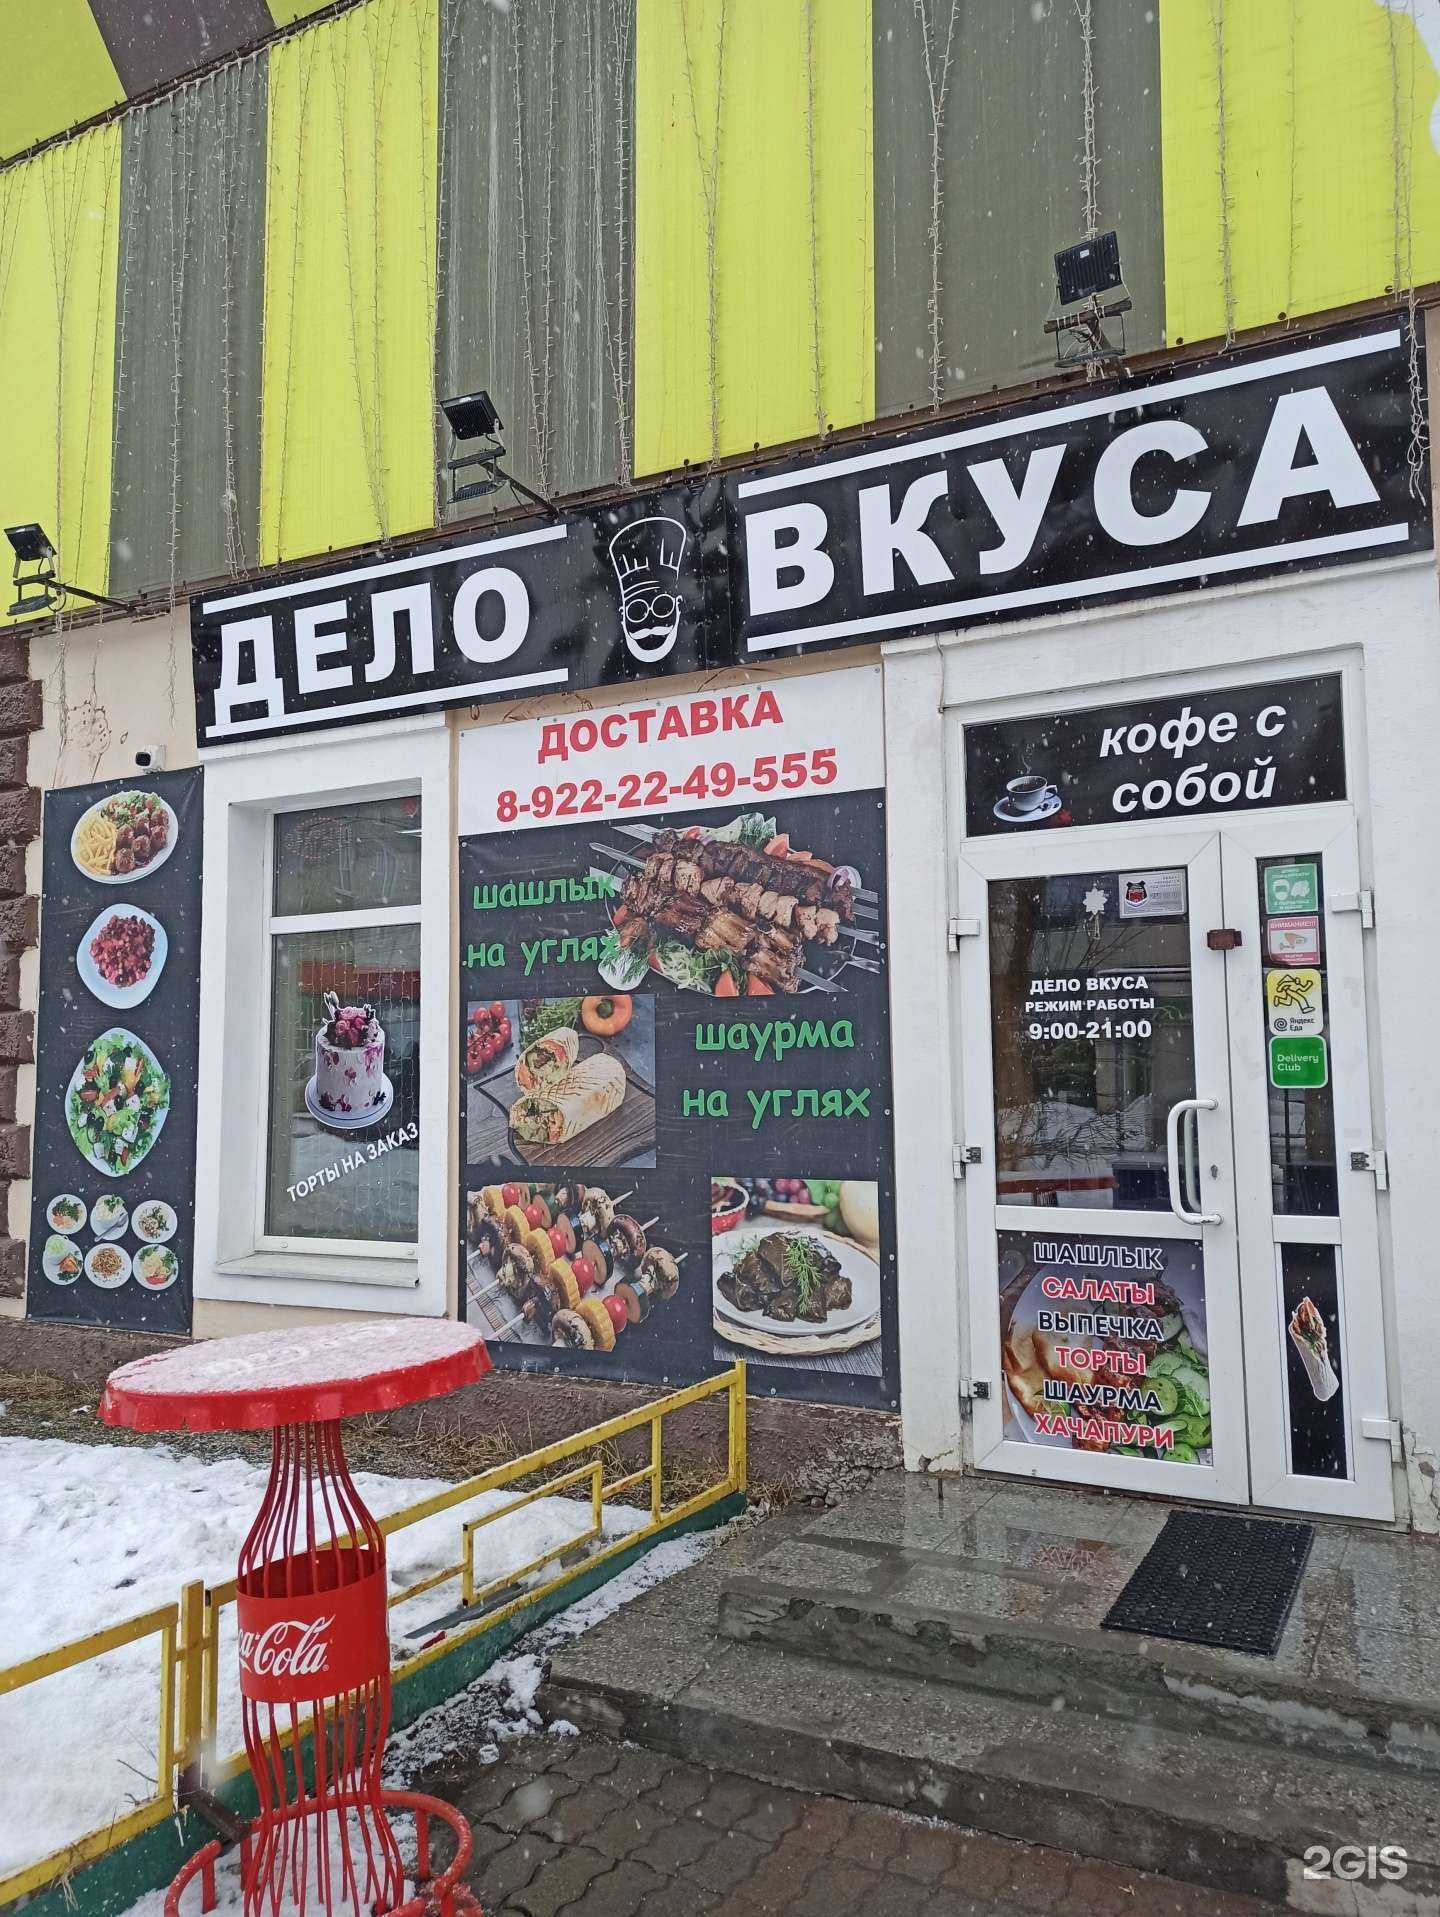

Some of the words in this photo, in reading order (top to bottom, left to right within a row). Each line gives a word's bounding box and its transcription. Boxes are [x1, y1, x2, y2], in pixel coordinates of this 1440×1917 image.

[212, 566, 530, 727] ДЕЛО
[744, 385, 1381, 617] ВКУСА
[537, 689, 784, 764] ДОСТАВКА
[1099, 706, 1238, 759] кофе
[1255, 705, 1287, 738] с
[495, 747, 838, 823] 8-922-22-49-555
[1112, 755, 1277, 814] собой
[473, 875, 616, 910] шашлык
[467, 942, 506, 969] на
[520, 936, 621, 976] углях
[1029, 978, 1081, 996] ДЕЛО
[1086, 975, 1149, 992] ВКУСА
[1025, 1000, 1082, 1013] РЕЖИМ
[1086, 997, 1155, 1011] РАБОТЫ
[695, 1019, 855, 1062] шаурма
[1028, 1020, 1153, 1040] 9:00-21:00
[1277, 1054, 1319, 1064] Delivery
[1277, 1063, 1301, 1071] Club
[683, 1088, 729, 1118] на
[746, 1087, 872, 1130] углях
[286, 1163, 341, 1202] ТОРТЫ
[340, 1150, 367, 1174] НА
[366, 1122, 419, 1160] ЗАКАЗ
[1033, 1241, 1165, 1270] ШАШЛЫК
[1041, 1276, 1156, 1305] САЛАТЫ
[1037, 1309, 1165, 1341] ВЫПЕЧКА
[1055, 1345, 1146, 1376] ТОРТЫ
[1043, 1378, 1165, 1414] ШАУРМА
[1033, 1412, 1175, 1450] ХАЧАПУРИ
